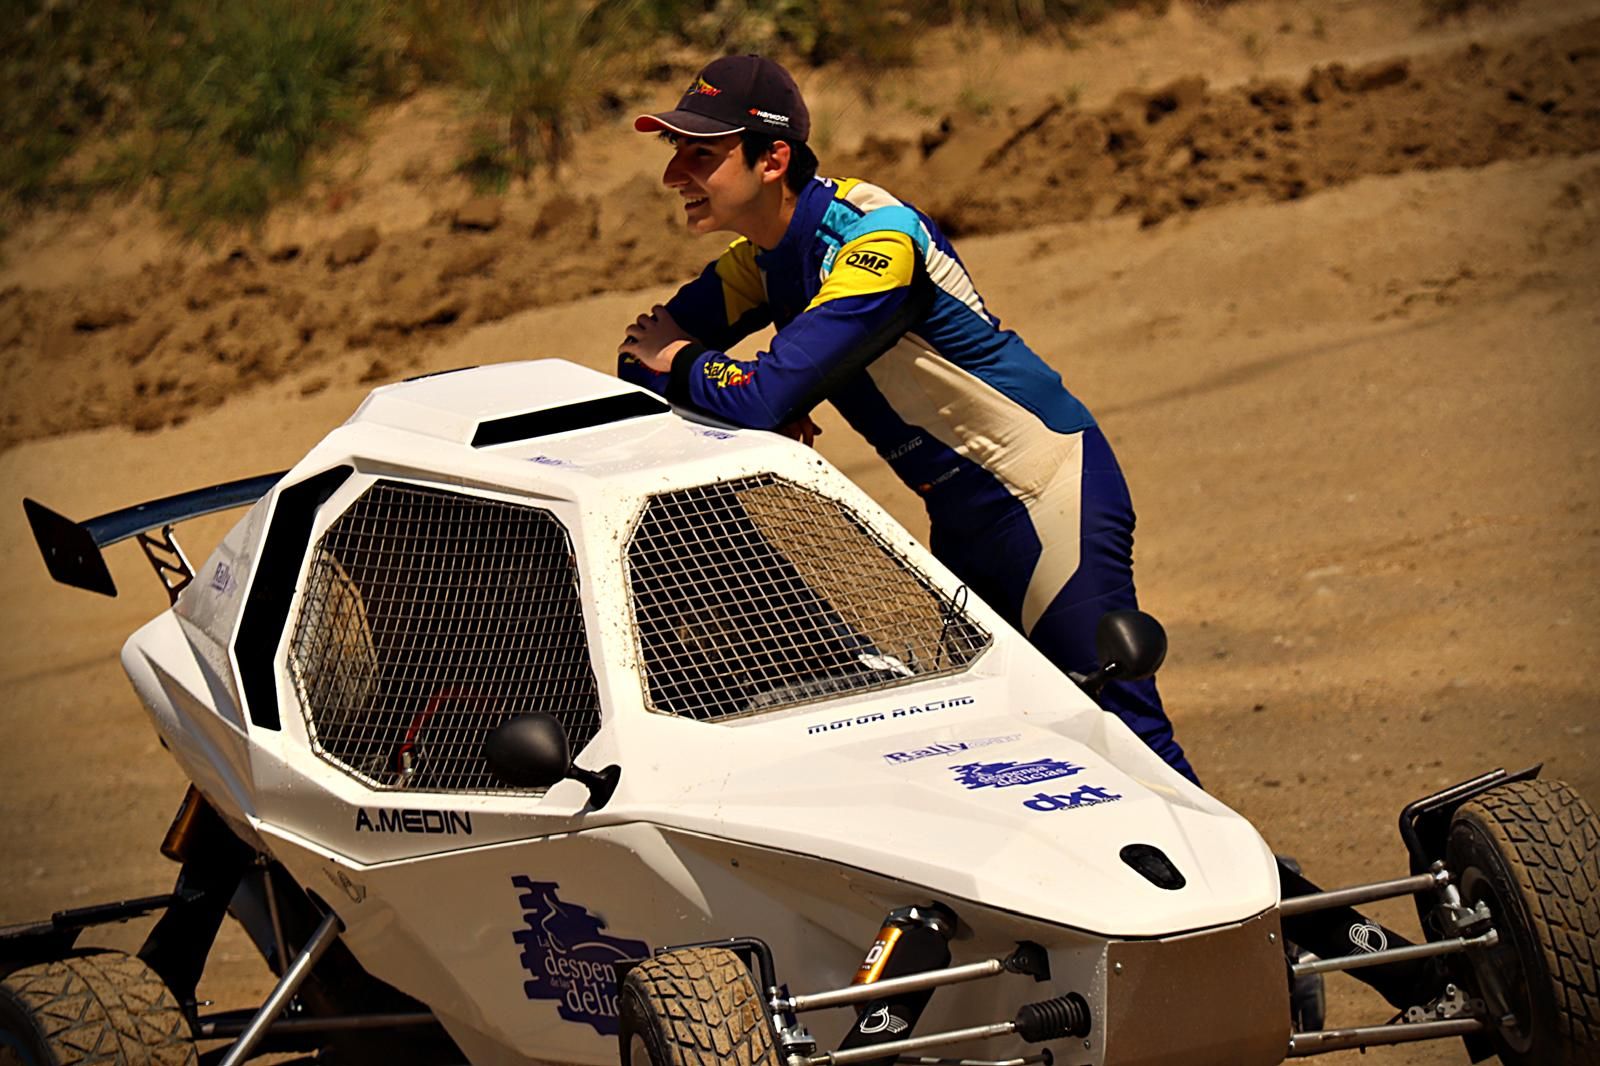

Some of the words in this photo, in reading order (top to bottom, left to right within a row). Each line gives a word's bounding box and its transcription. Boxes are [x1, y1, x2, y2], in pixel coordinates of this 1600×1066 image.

[846, 253, 889, 271] OMP
[808, 712, 885, 734] MOTOR
[892, 695, 975, 718] RACING
[1022, 785, 1123, 812] dxt
[355, 807, 473, 835] A.MEDIN
